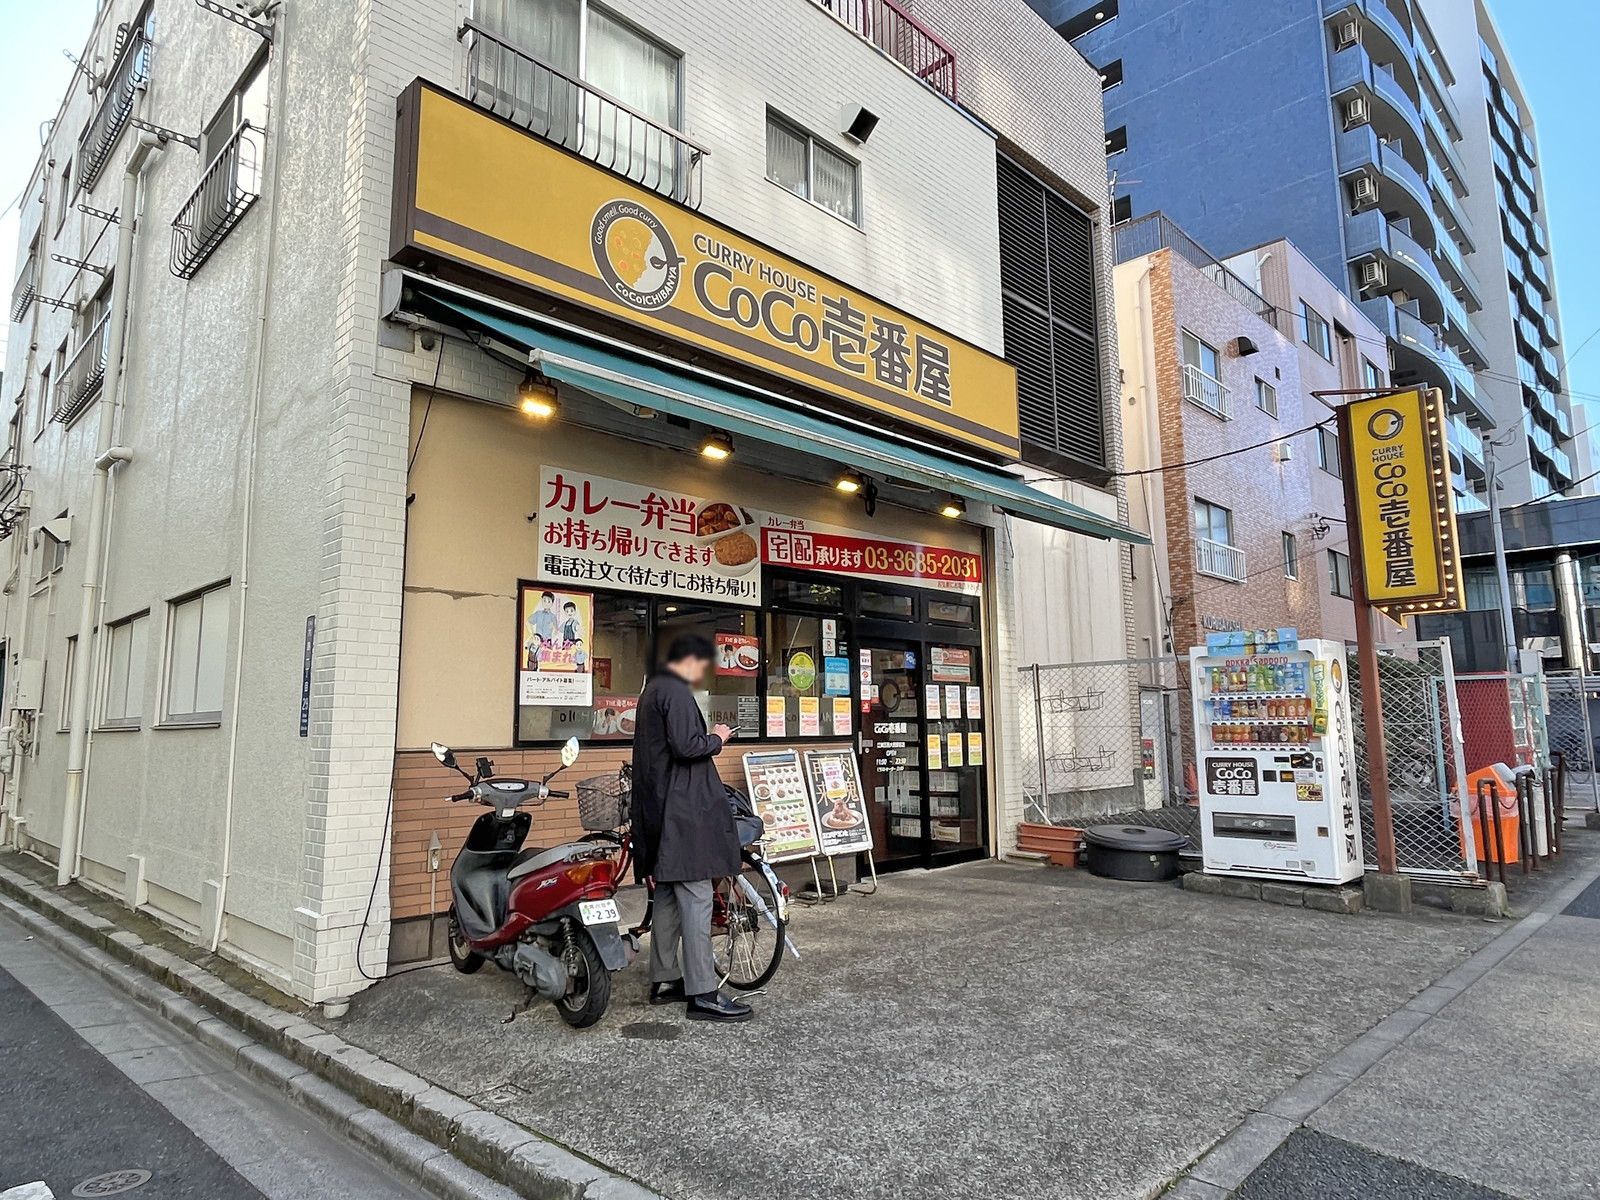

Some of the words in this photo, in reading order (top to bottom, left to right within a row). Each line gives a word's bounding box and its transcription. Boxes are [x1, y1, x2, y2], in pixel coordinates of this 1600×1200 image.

[618, 204, 639, 217] Good
[638, 210, 658, 230] curry
[692, 234, 755, 275] CURRY
[758, 262, 817, 304] HOUSE
[692, 260, 953, 407] CoCo壱番屋
[1371, 444, 1404, 456] CURRY
[1372, 450, 1405, 463] HOUSE
[545, 474, 696, 535] カレー弁当
[767, 516, 805, 530] カレー弁当
[543, 517, 715, 567] お持ち帰りできます
[1378, 499, 1417, 589] 壱番屋
[543, 553, 757, 599] 電話注文で待たずにお持ち帰り!
[864, 545, 978, 579] 03-3685-2031
[1212, 779, 1257, 795] 壱番屋
[1215, 767, 1252, 779] CoCo
